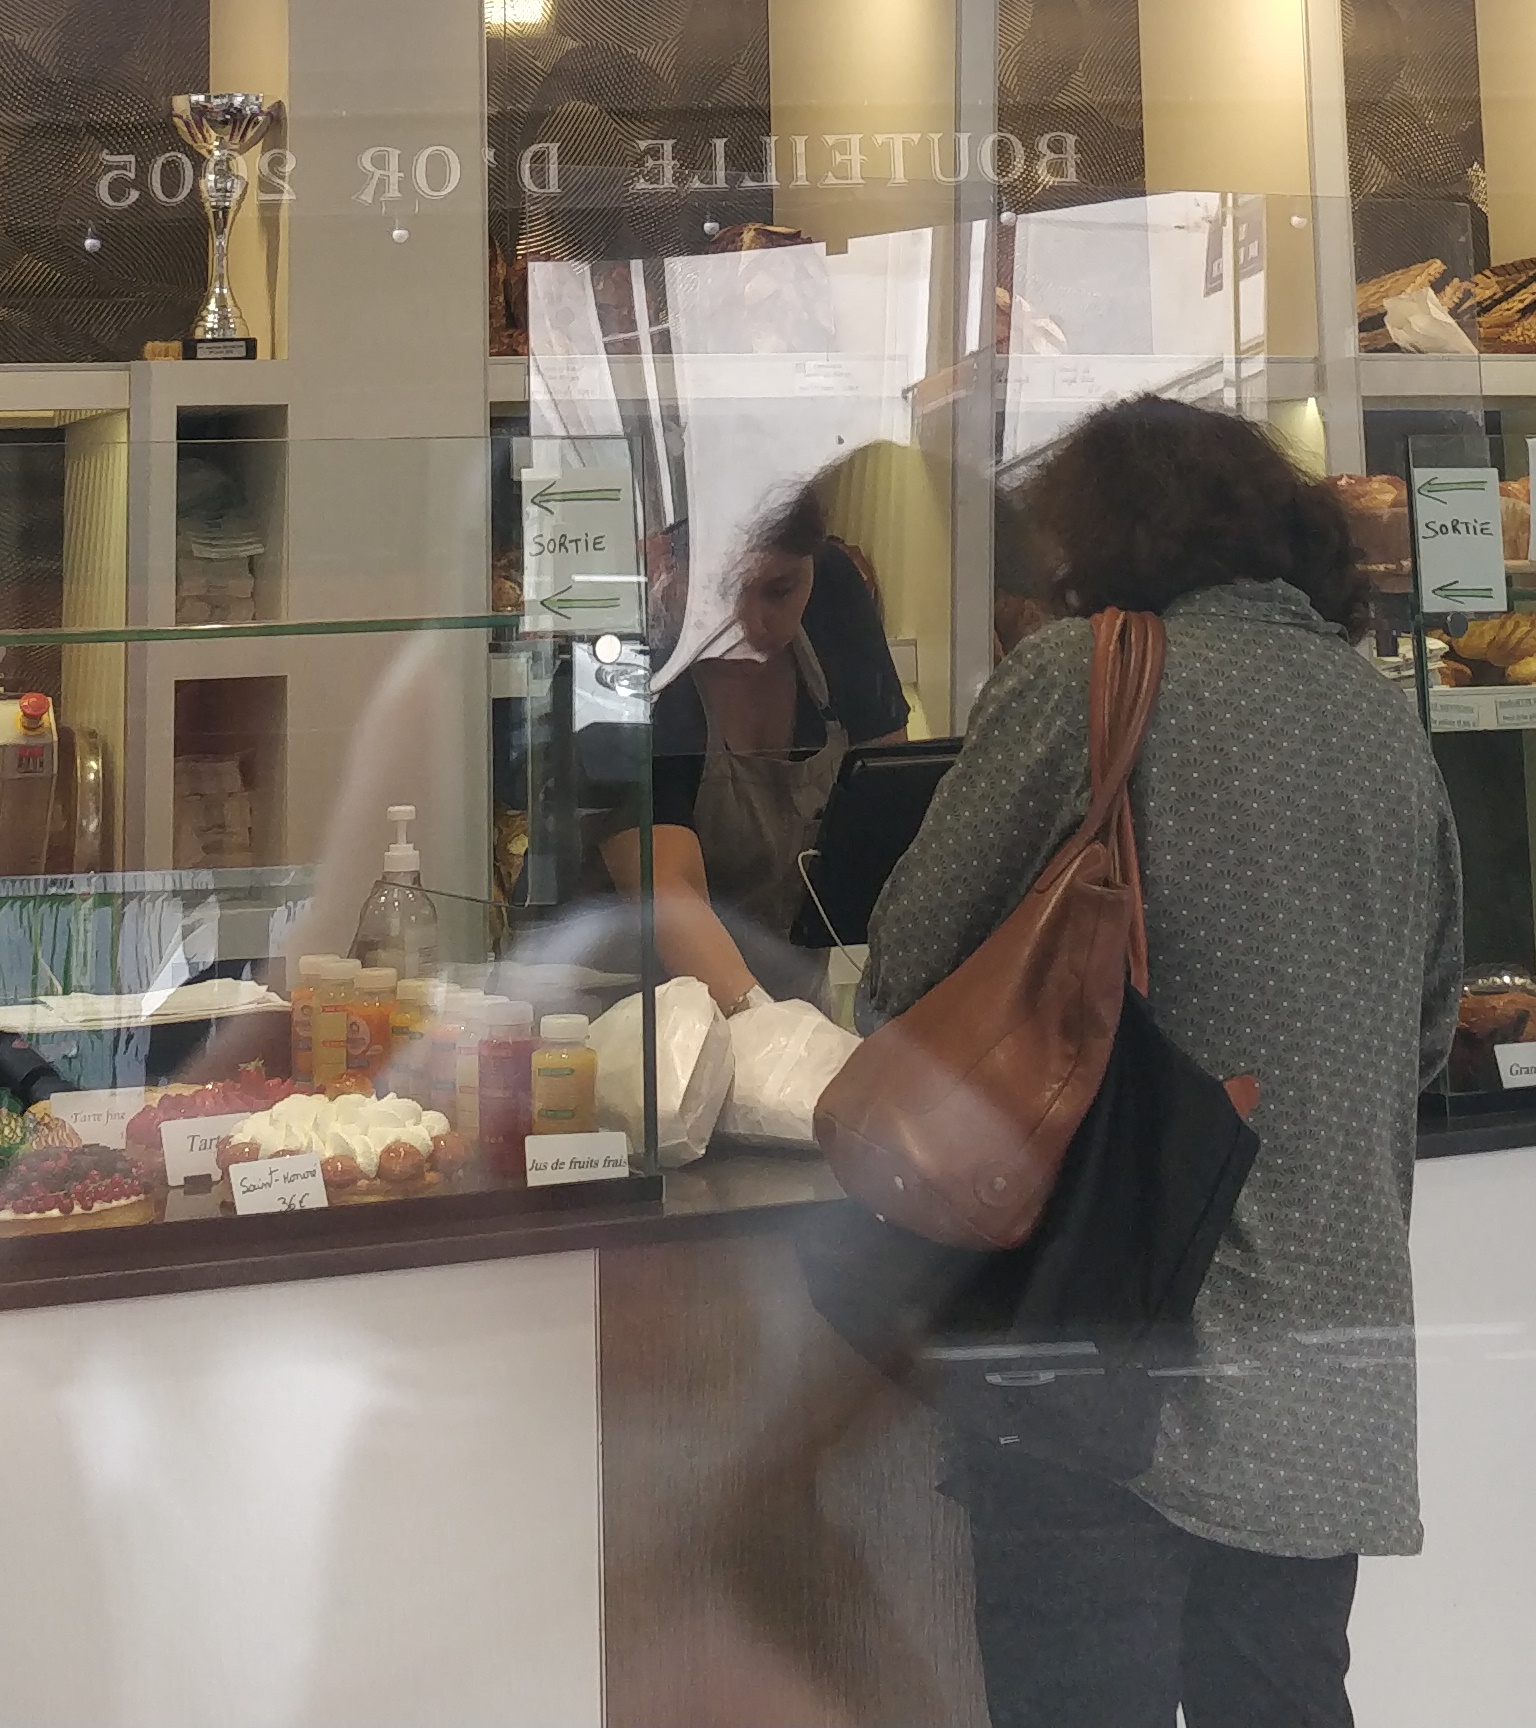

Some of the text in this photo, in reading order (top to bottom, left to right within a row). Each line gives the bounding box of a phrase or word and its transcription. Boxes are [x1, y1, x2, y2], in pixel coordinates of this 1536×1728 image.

[72, 1110, 102, 1124] Tarte
[187, 1133, 221, 1153] Tart
[528, 1154, 627, 1172] Jus de fruits frais
